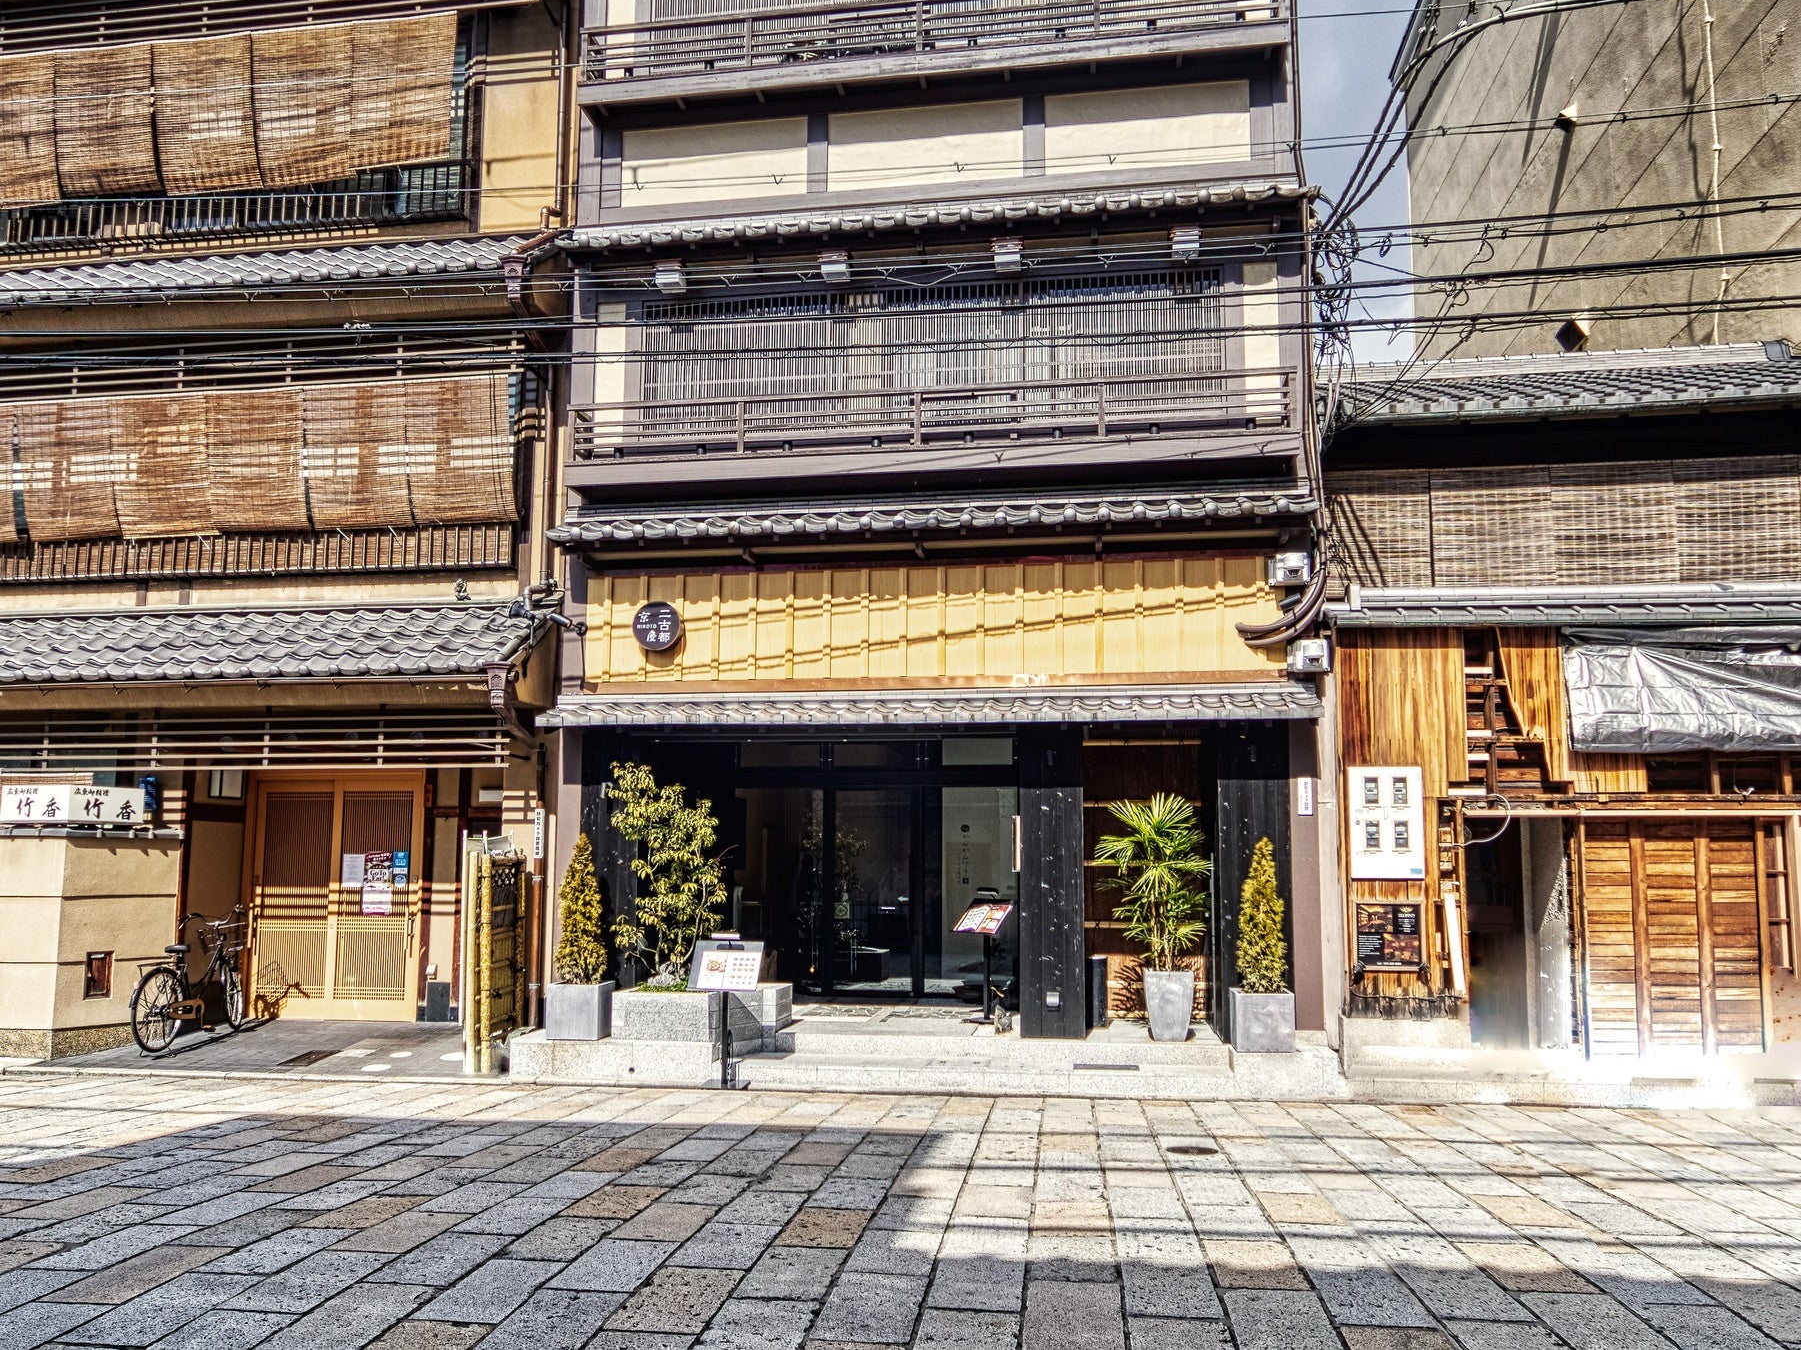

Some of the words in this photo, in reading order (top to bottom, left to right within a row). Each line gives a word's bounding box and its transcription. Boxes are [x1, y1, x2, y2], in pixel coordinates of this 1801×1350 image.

[658, 609, 672, 643] 二古都
[16, 796, 61, 818] 竹香
[83, 797, 136, 821] 竹香
